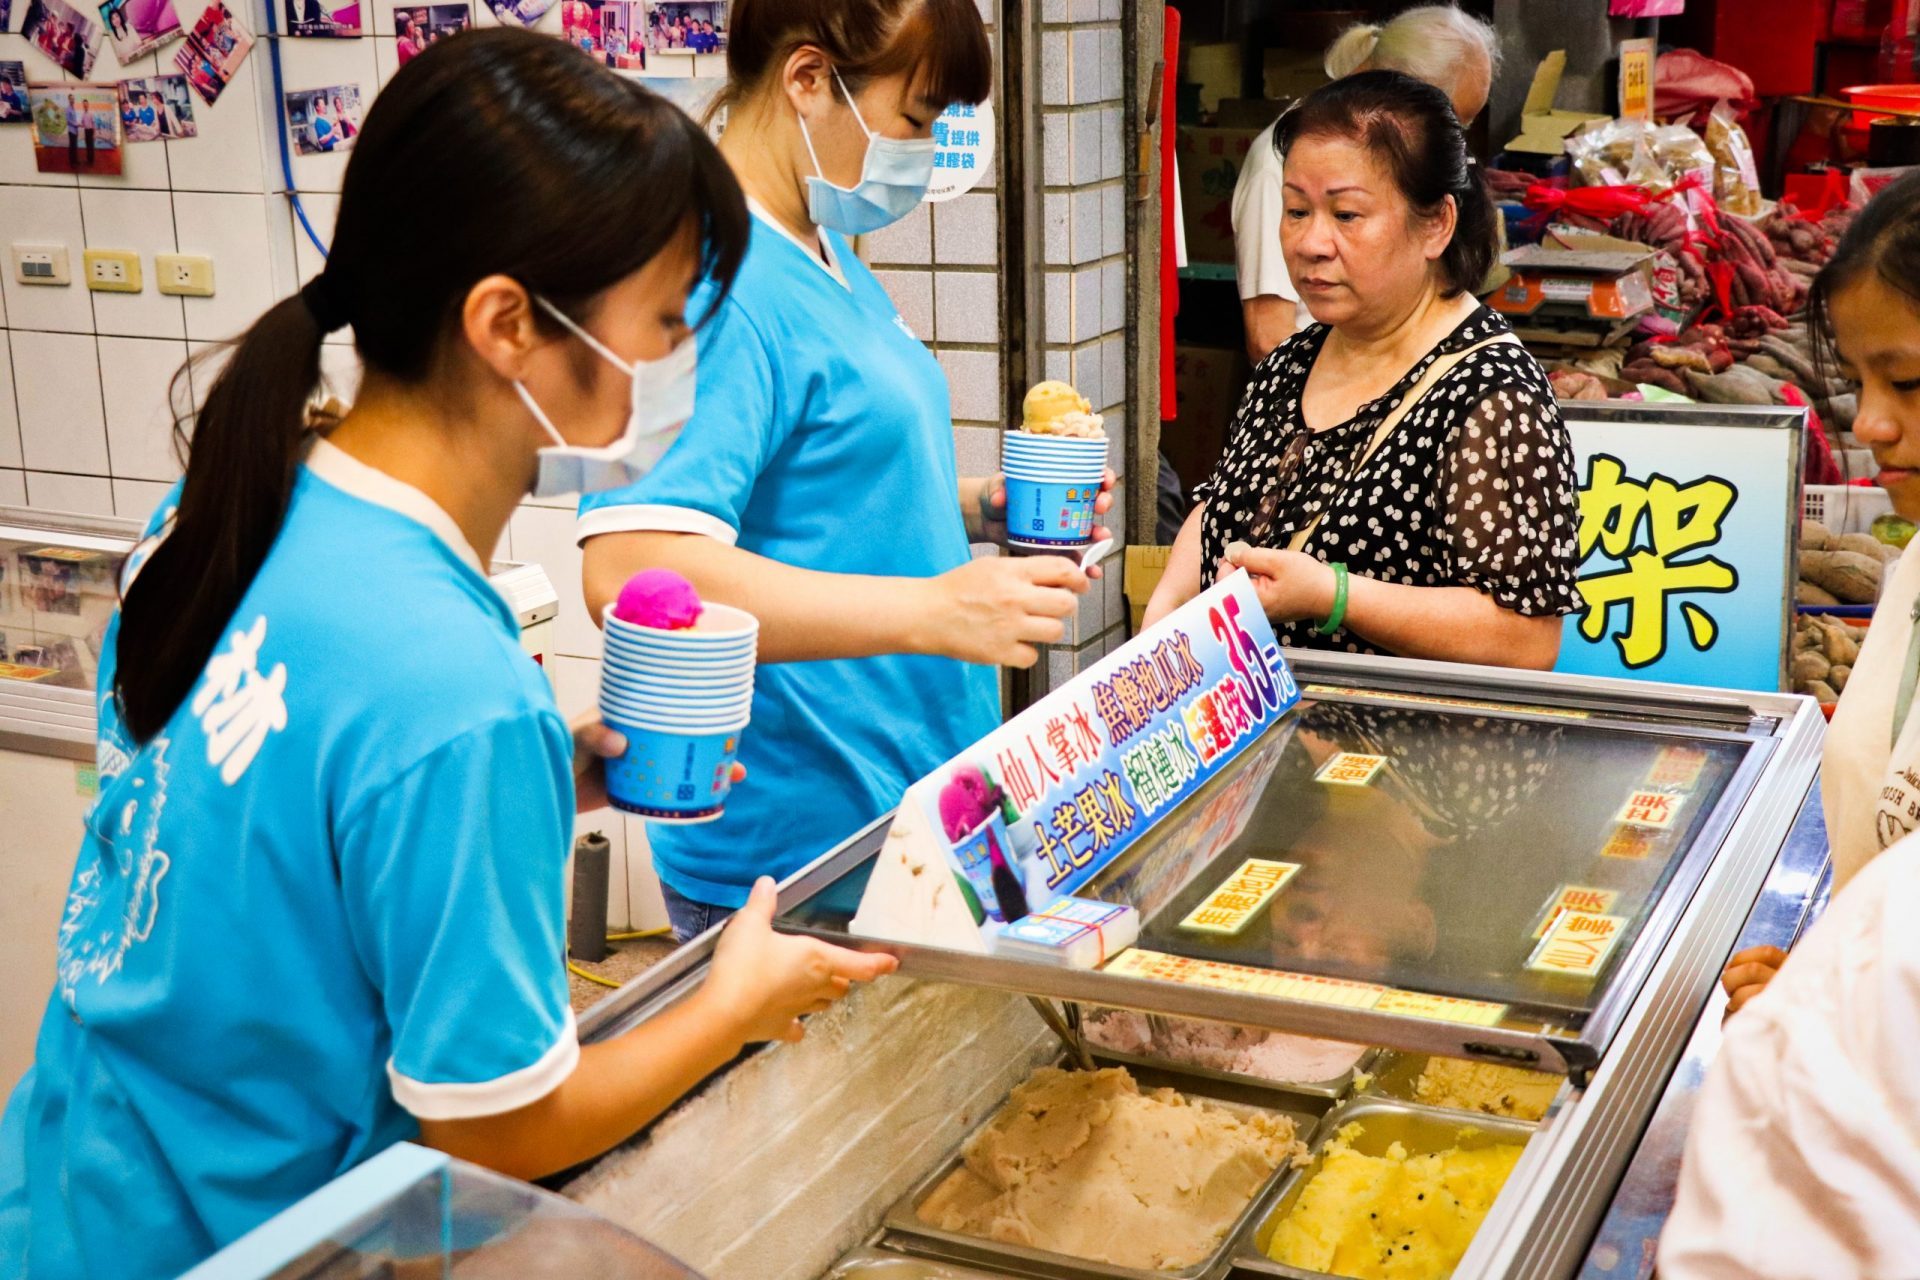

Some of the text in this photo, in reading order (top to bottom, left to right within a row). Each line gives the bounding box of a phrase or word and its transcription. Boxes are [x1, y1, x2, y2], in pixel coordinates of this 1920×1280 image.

[1577, 453, 1739, 670] 架
[998, 628, 1204, 813] 仙人掌冰 焦糖地瓜冰
[1033, 769, 1136, 890] 土芒果冰
[1124, 722, 1197, 813] 榴槤冰
[1193, 863, 1293, 927] 焦糖地瓜
[1541, 916, 1615, 969] 仙人掌
